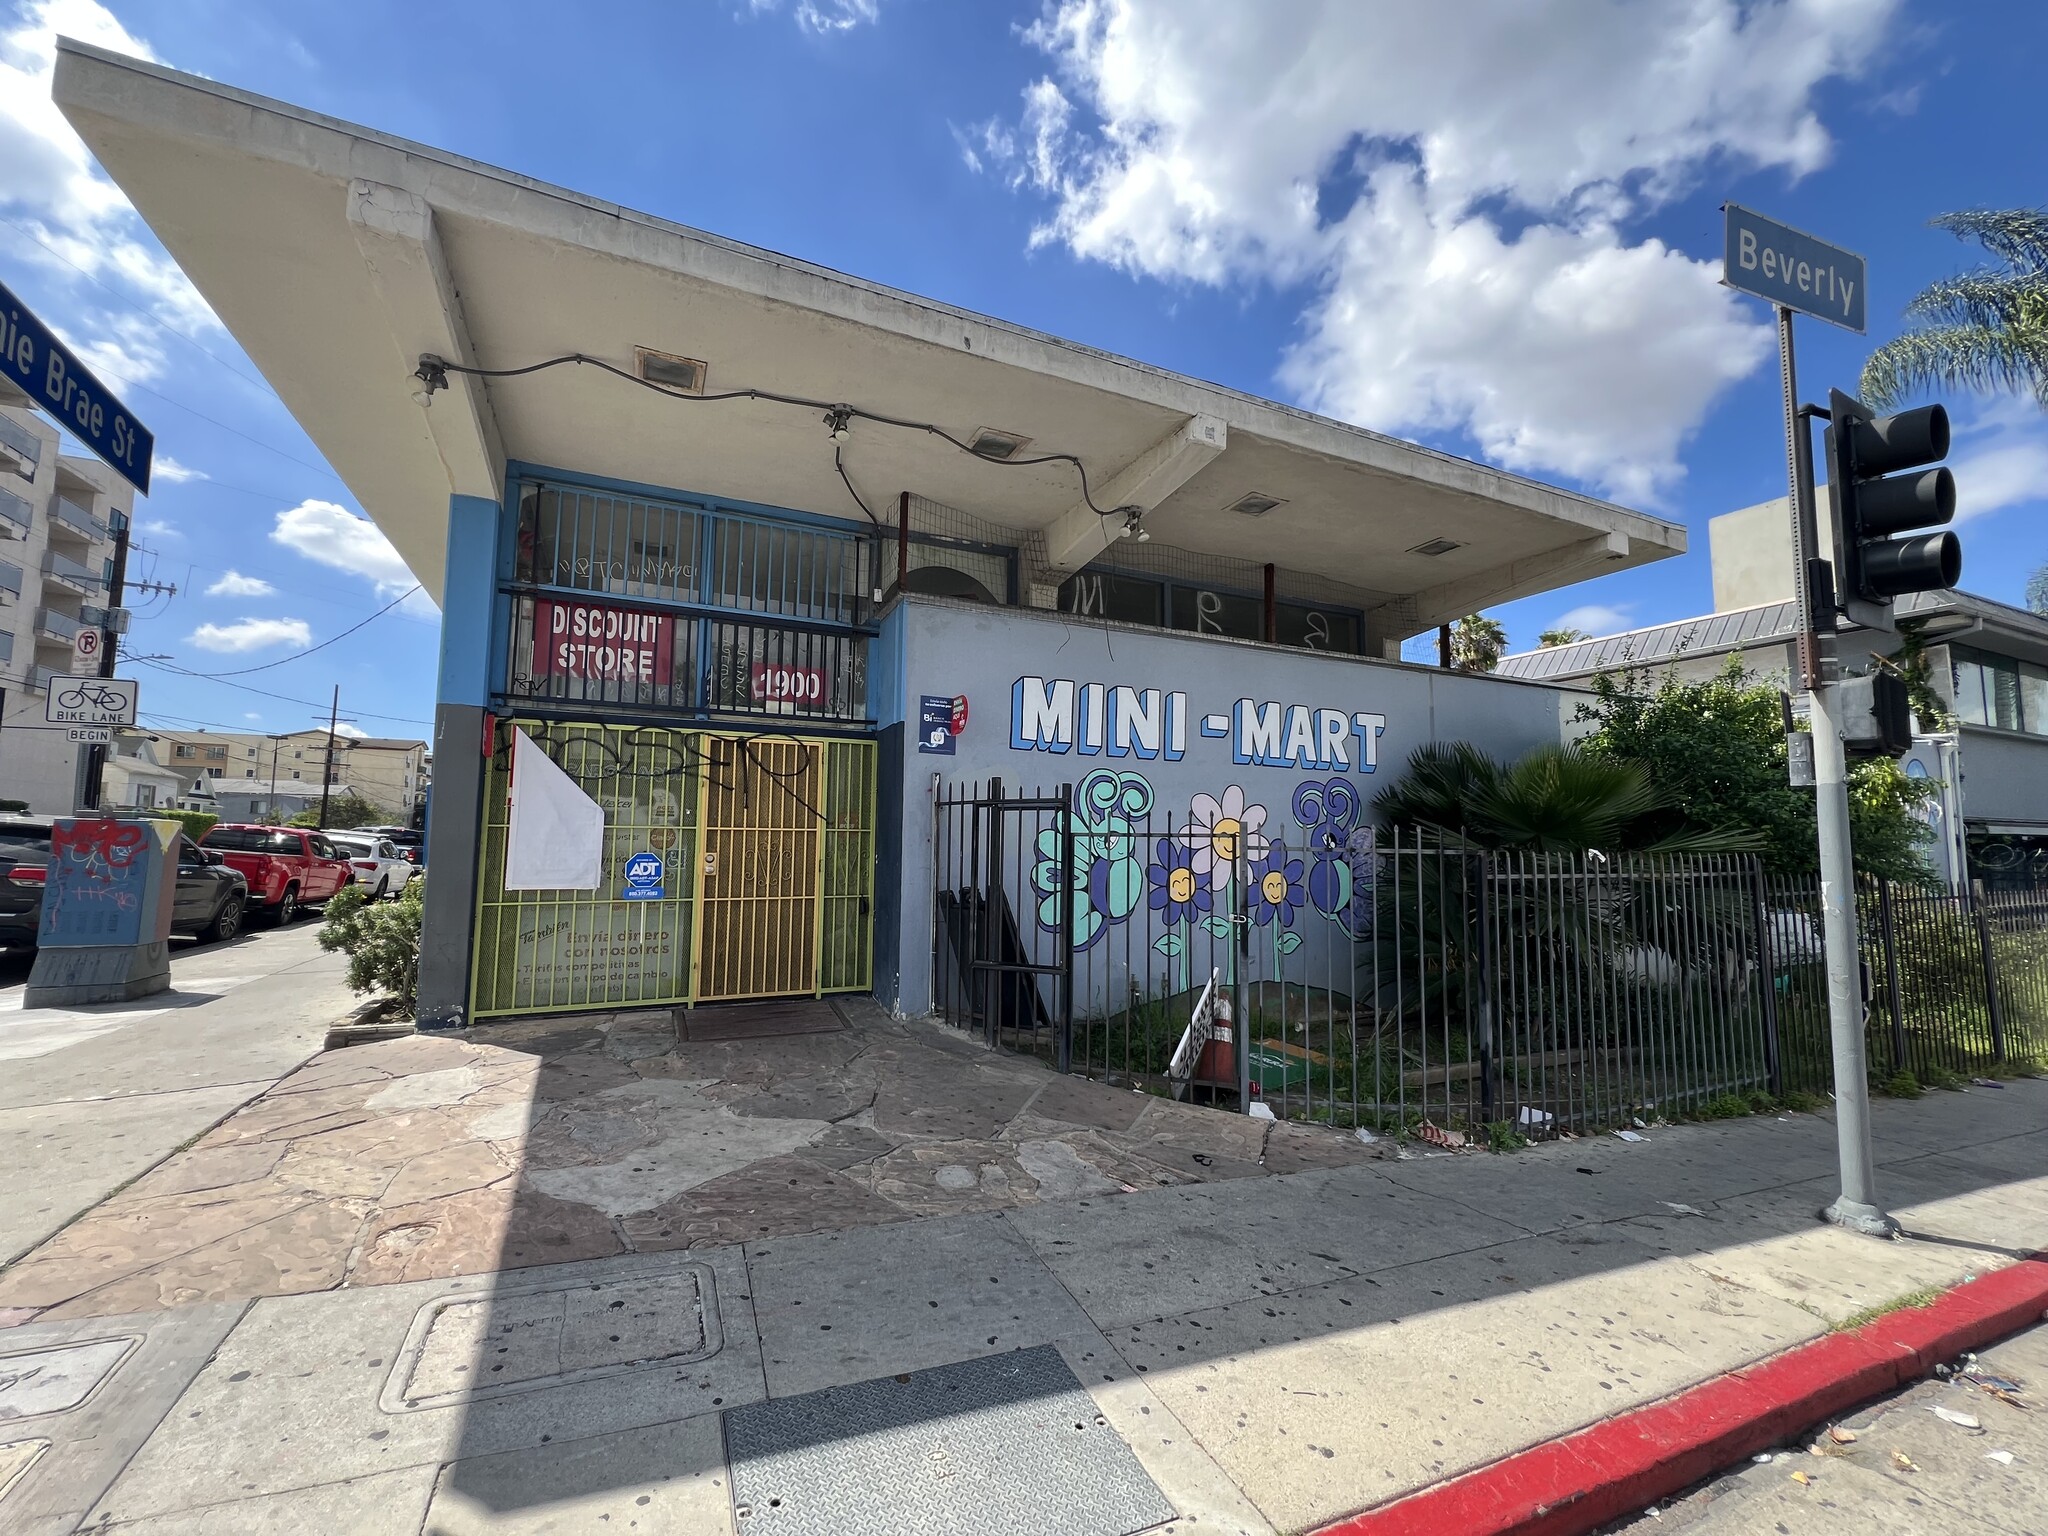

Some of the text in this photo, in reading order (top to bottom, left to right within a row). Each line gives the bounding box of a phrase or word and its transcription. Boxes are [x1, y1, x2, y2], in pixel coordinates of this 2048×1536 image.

[1739, 228, 1854, 316] Beverly
[46, 348, 104, 438] Brae
[111, 414, 135, 467] St
[553, 605, 663, 643] DISCOUNT
[558, 642, 653, 674] STORE
[760, 668, 820, 699] 1900
[57, 711, 125, 723] BIKE LANE
[70, 730, 108, 740] BEGIN
[629, 862, 659, 876] ADT
[627, 970, 668, 980] cambo
